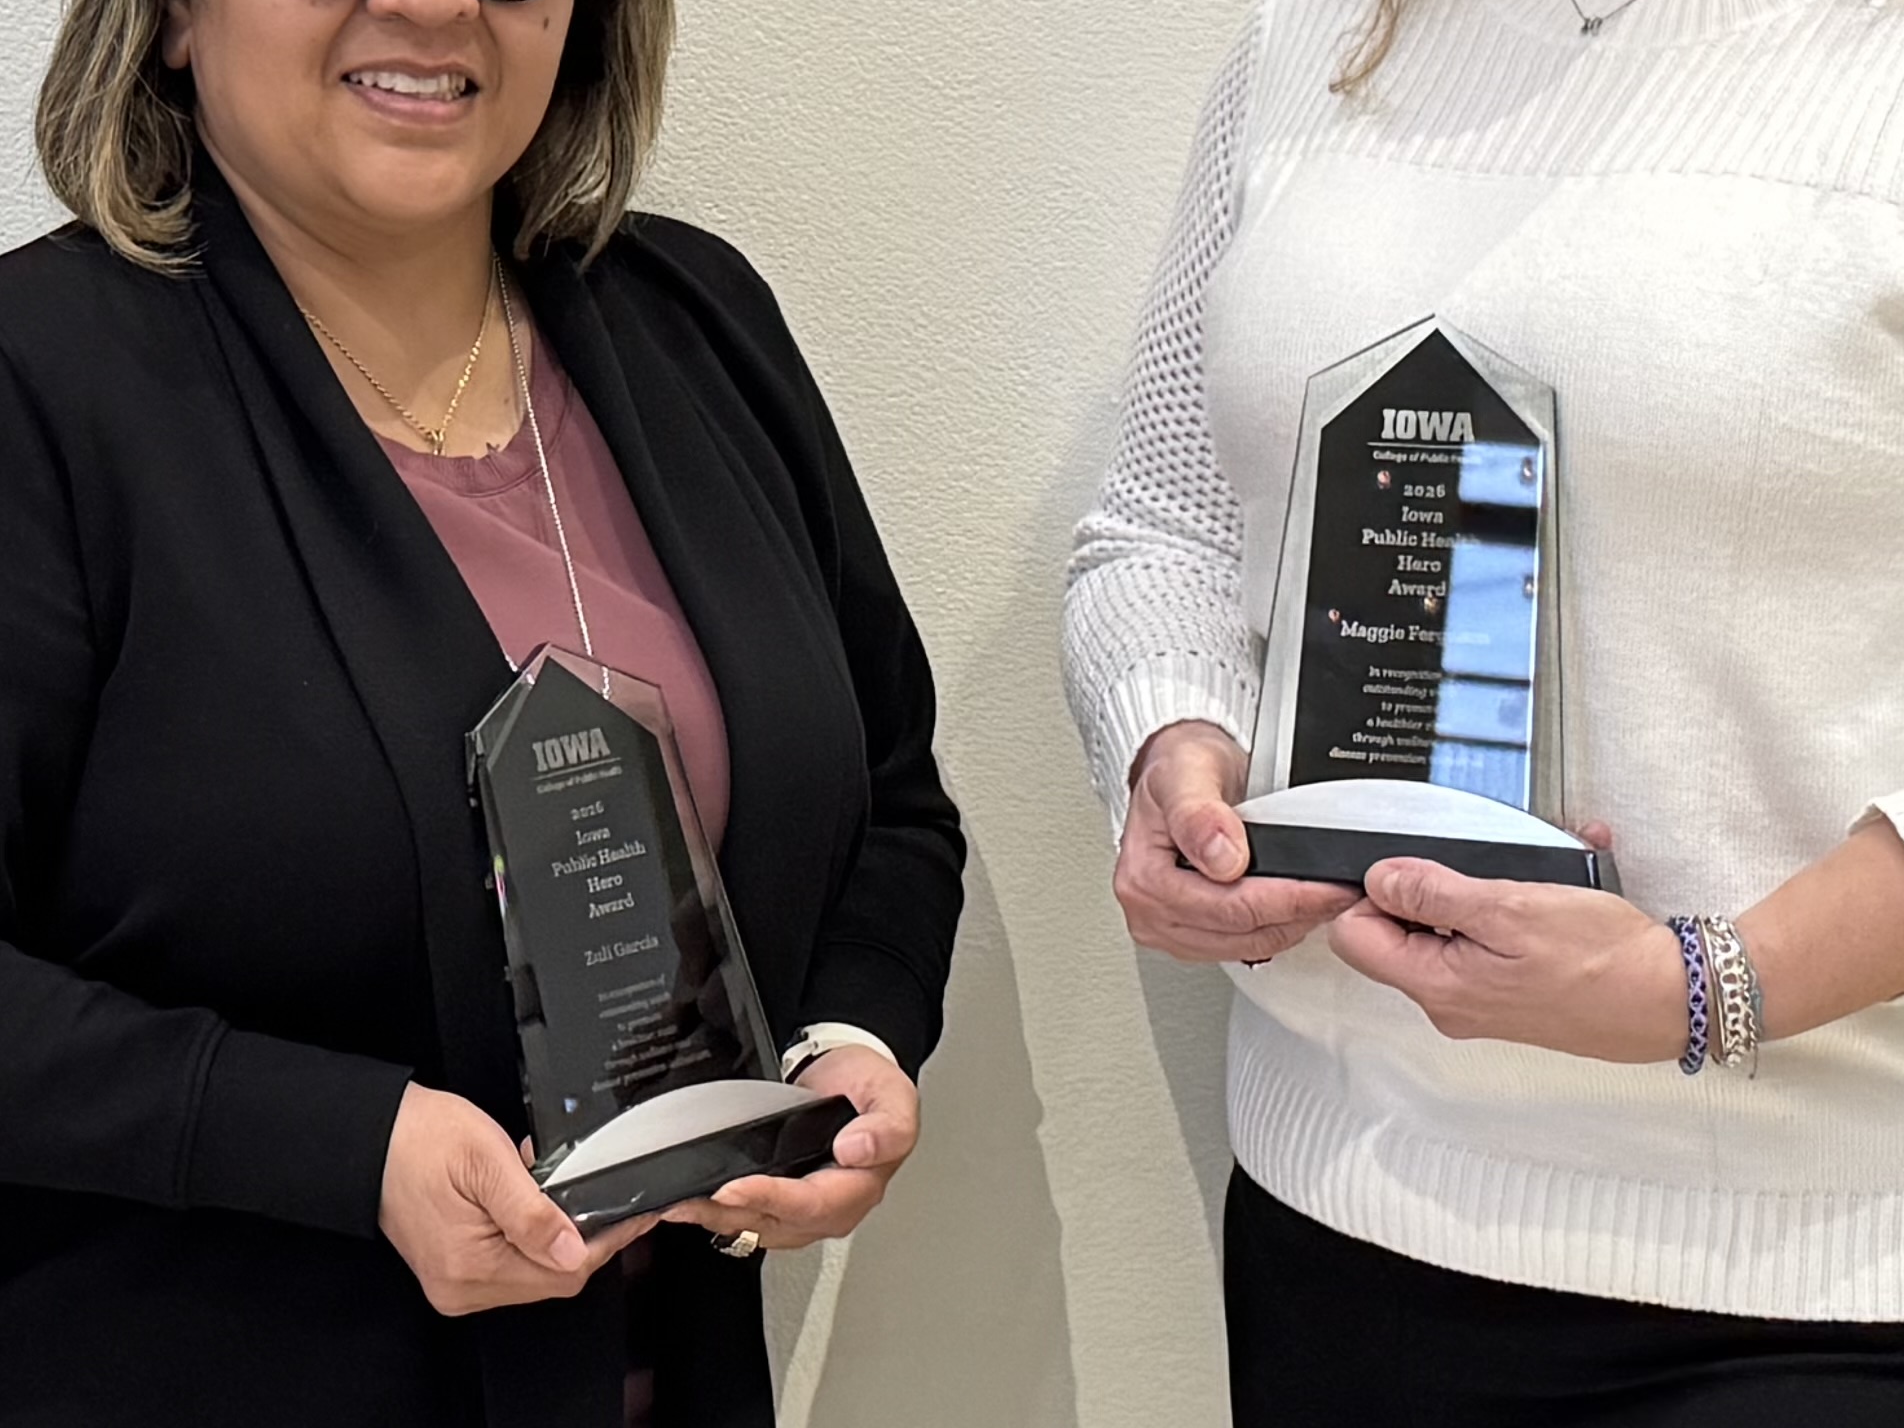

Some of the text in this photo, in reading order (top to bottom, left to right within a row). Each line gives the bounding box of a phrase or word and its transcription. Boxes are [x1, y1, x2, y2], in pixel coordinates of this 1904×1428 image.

[1380, 408, 1475, 443] IOWA
[1403, 484, 1446, 499] 2026
[1401, 505, 1444, 524] Iowa
[1361, 528, 1418, 547] Public
[1396, 555, 1442, 573] Hero
[1388, 578, 1446, 597] Award
[1340, 620, 1406, 644] Maggie
[532, 727, 611, 772] IOWA
[575, 825, 611, 846] Iowa
[551, 839, 647, 878] Public Health
[585, 874, 623, 894] Hero
[588, 892, 635, 919] Award
[584, 945, 613, 967] Zuli
